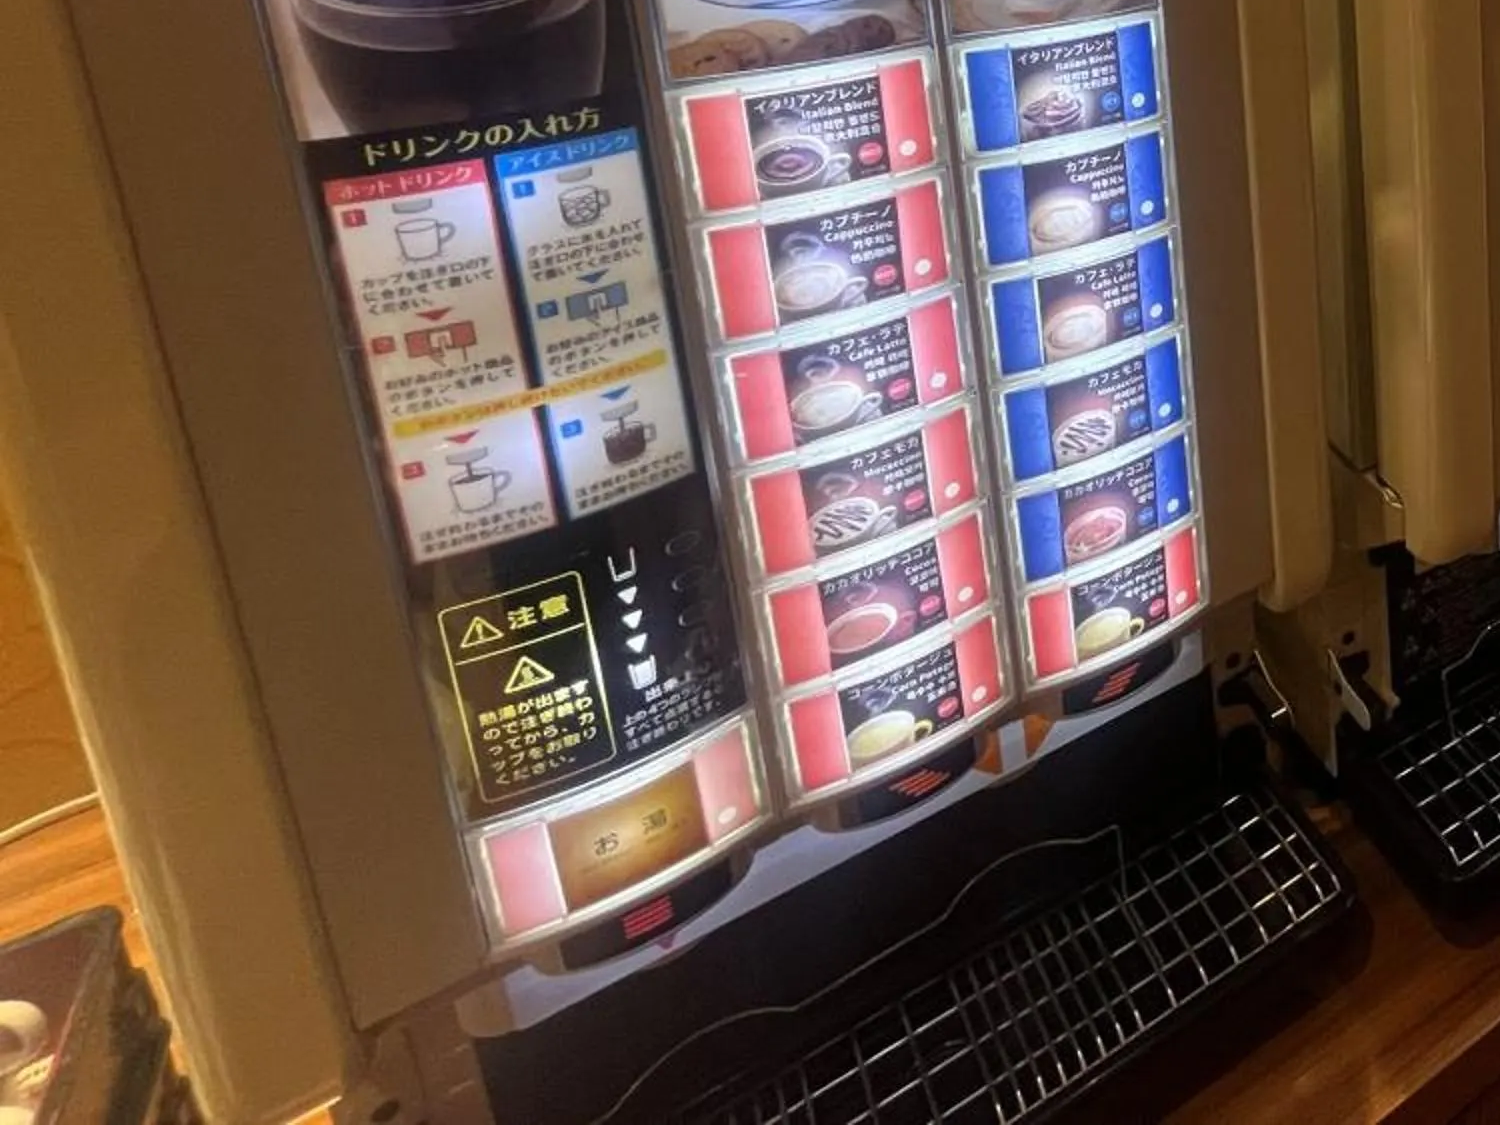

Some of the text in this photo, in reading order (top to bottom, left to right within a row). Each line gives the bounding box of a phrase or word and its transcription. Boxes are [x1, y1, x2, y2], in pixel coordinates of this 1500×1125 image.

[1017, 36, 1116, 66] イタリアンブレンド
[754, 81, 878, 115] イタリアンブレンド
[800, 97, 878, 121] Italian Blend
[364, 107, 600, 167] ドリンクの入れ方
[509, 134, 630, 170] アイスドリンク
[1065, 150, 1122, 175] カプチーノ
[340, 166, 472, 200] ホットドリンク
[819, 205, 892, 231] カプチーノ
[824, 219, 895, 243] Cappuccino
[850, 436, 920, 469] カフェモカ
[822, 541, 935, 595] カカオリッチココア
[507, 594, 571, 631] 注意
[847, 648, 954, 700] コーンポタージュ
[478, 678, 590, 728] 熱湯が出ます
[483, 696, 593, 742] ので注ぎ終わ
